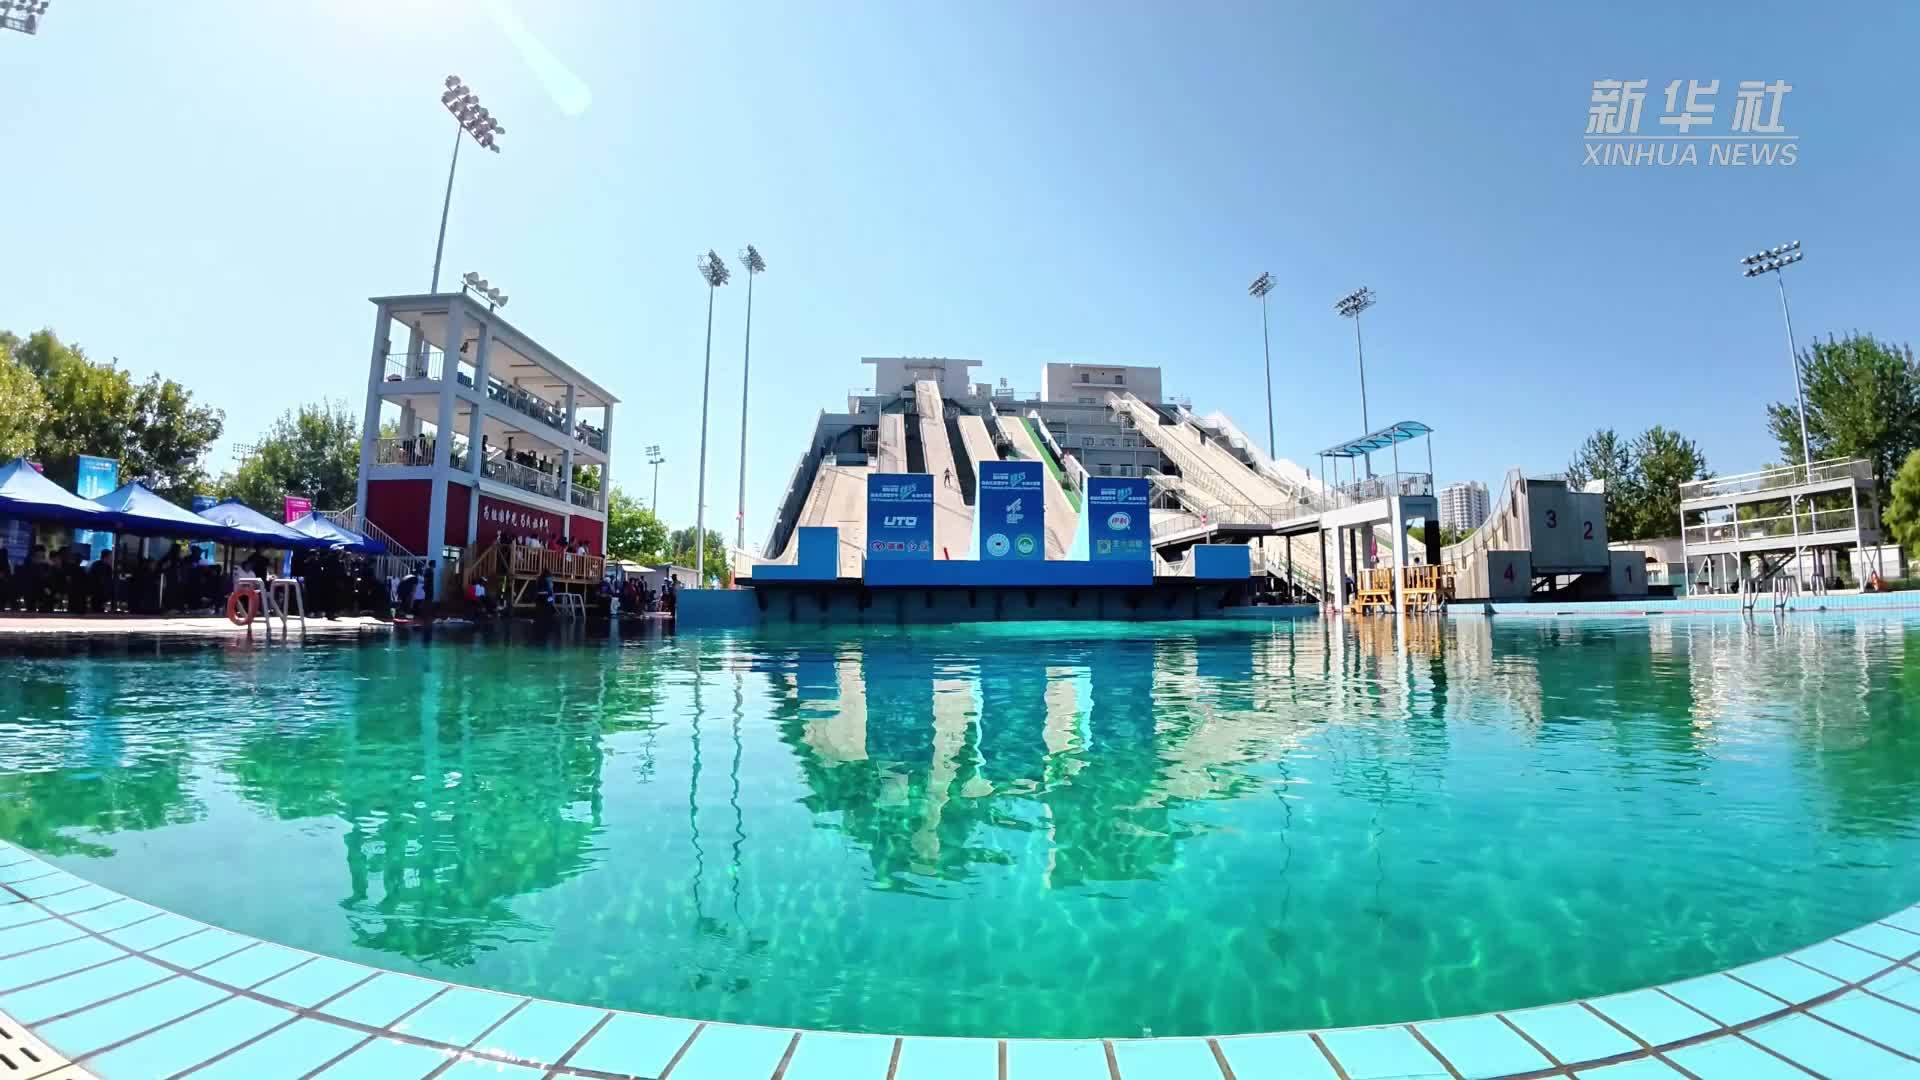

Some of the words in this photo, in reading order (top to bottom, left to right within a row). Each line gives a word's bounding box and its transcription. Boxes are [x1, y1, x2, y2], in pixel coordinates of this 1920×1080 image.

[1545, 509, 1557, 529] 3
[1583, 521, 1594, 540] 2
[1504, 562, 1515, 584] 4
[1624, 565, 1633, 584] 1
